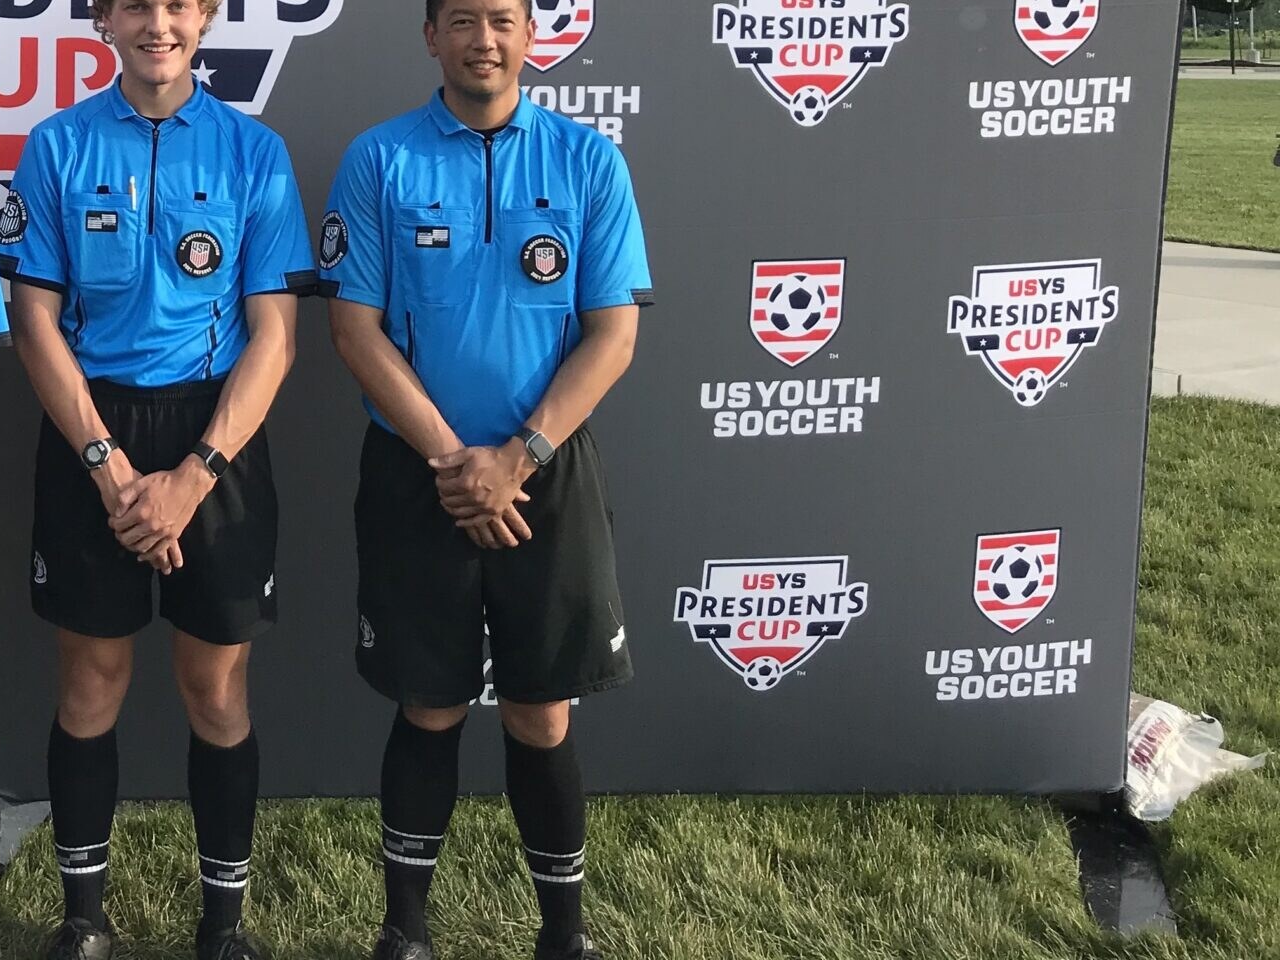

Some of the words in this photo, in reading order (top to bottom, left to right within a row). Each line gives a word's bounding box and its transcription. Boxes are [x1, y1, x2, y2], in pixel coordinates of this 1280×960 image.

[717, 8, 905, 39] PRESIDENTS
[780, 44, 843, 67] CUP
[981, 107, 1115, 137] SOCCER
[193, 243, 209, 253] USA
[537, 249, 553, 259] USA
[1009, 278, 1064, 297] USYS
[951, 290, 1115, 329] PRESIDENTS
[1006, 328, 1061, 351] CUP
[714, 407, 863, 437] SOCCER
[743, 573, 806, 590] USYS
[678, 586, 864, 618] PRESIDENTS
[738, 620, 800, 640] CUP
[937, 669, 1077, 700] SOCCER
